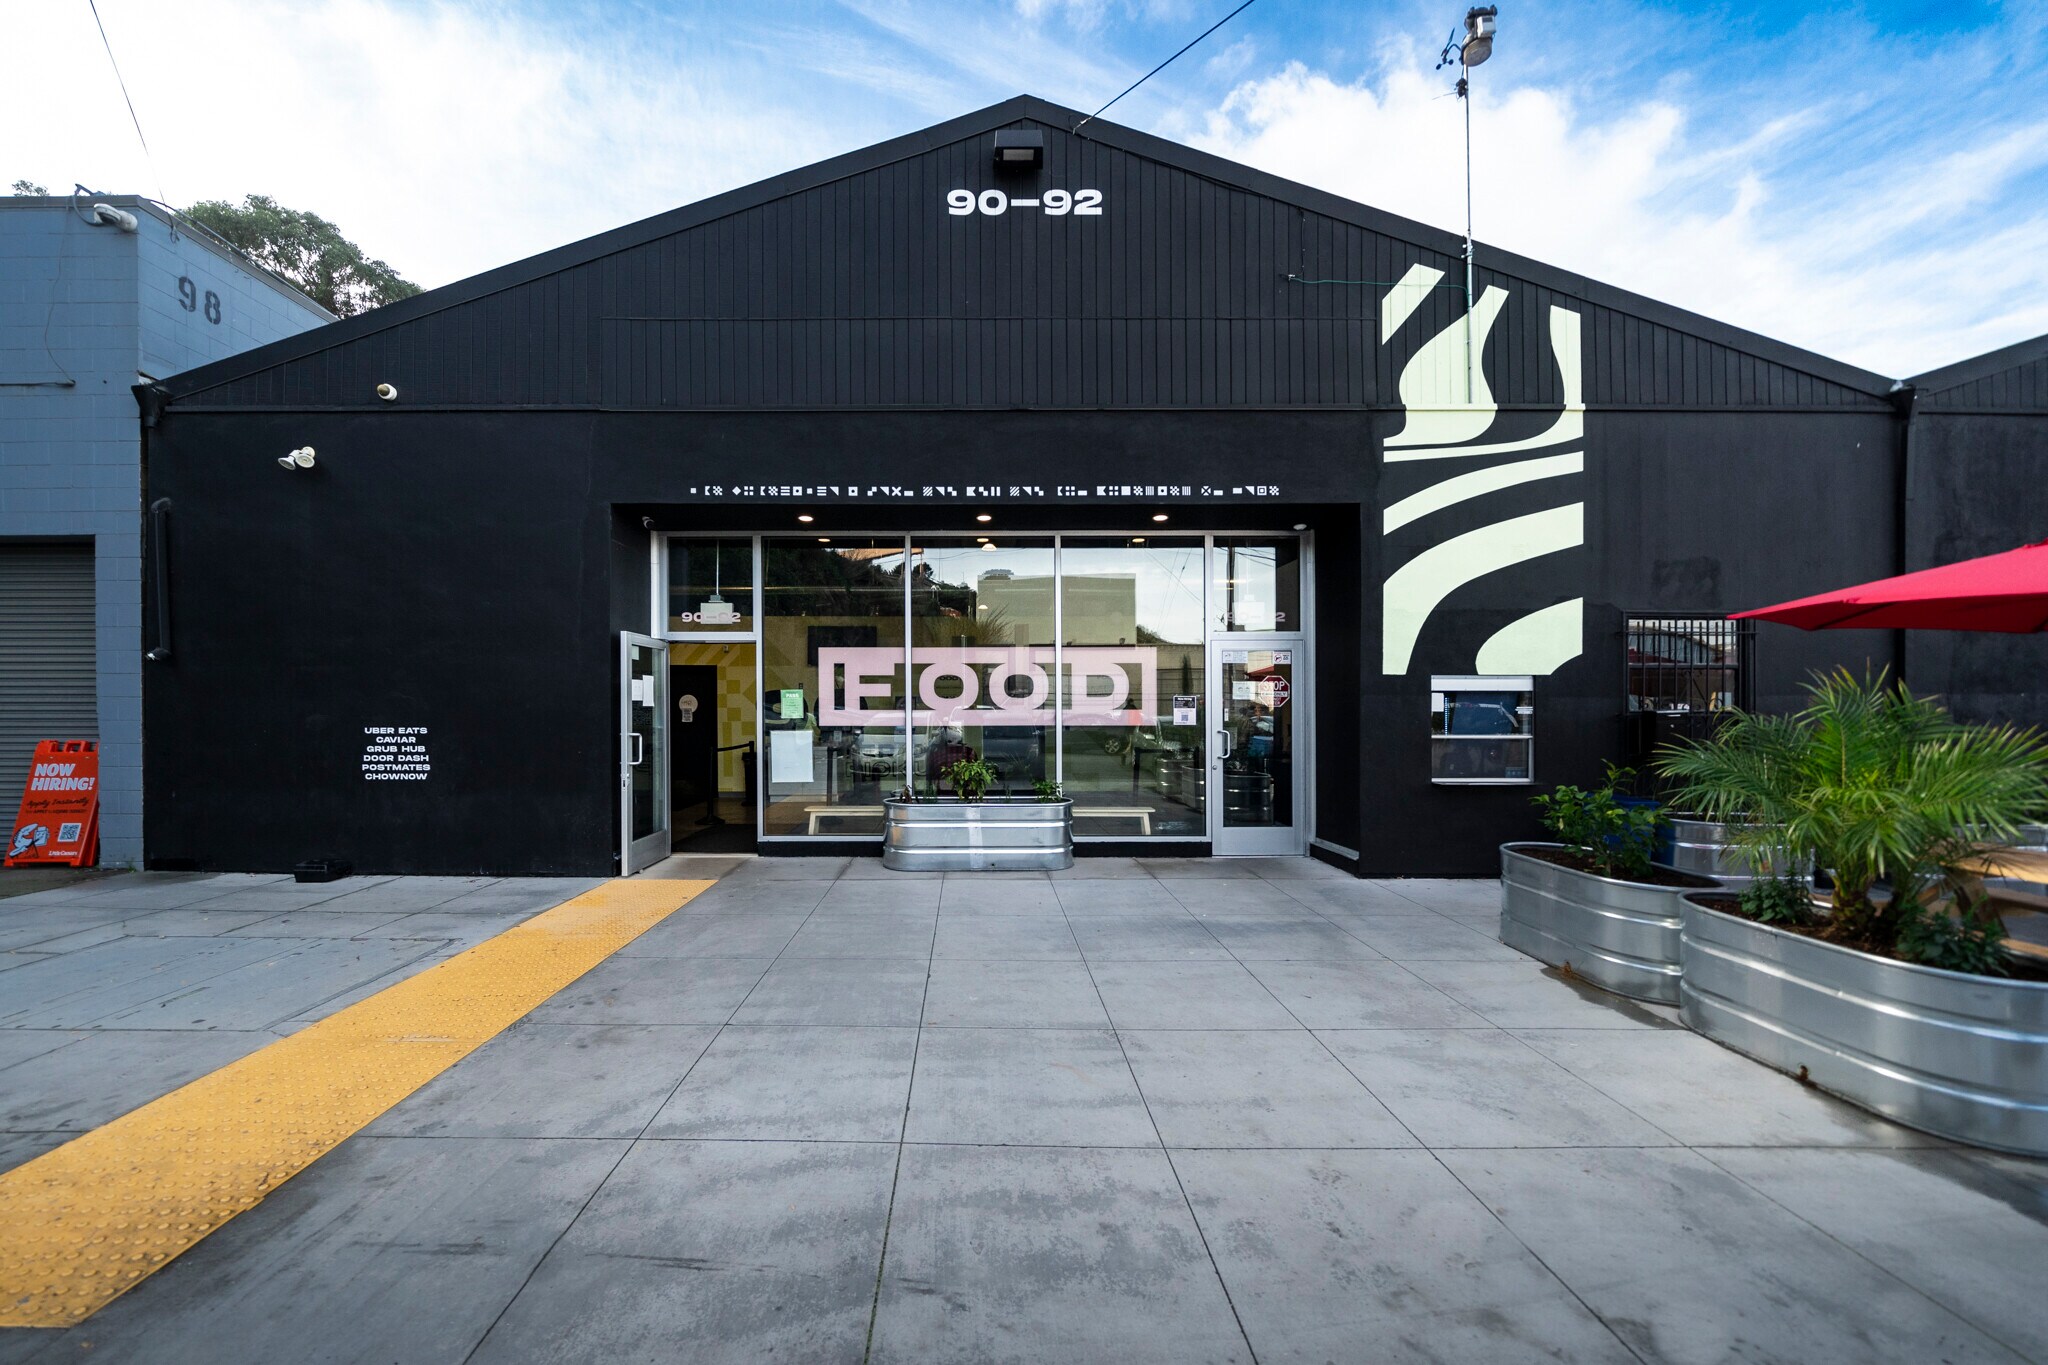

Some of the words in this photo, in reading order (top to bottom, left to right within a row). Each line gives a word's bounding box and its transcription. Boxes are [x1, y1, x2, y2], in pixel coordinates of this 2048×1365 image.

[178, 276, 222, 325] 98
[842, 660, 1132, 713] FOOD
[1263, 681, 1285, 691] STOP
[34, 763, 76, 777] NOW
[31, 777, 95, 791] HIRING!
